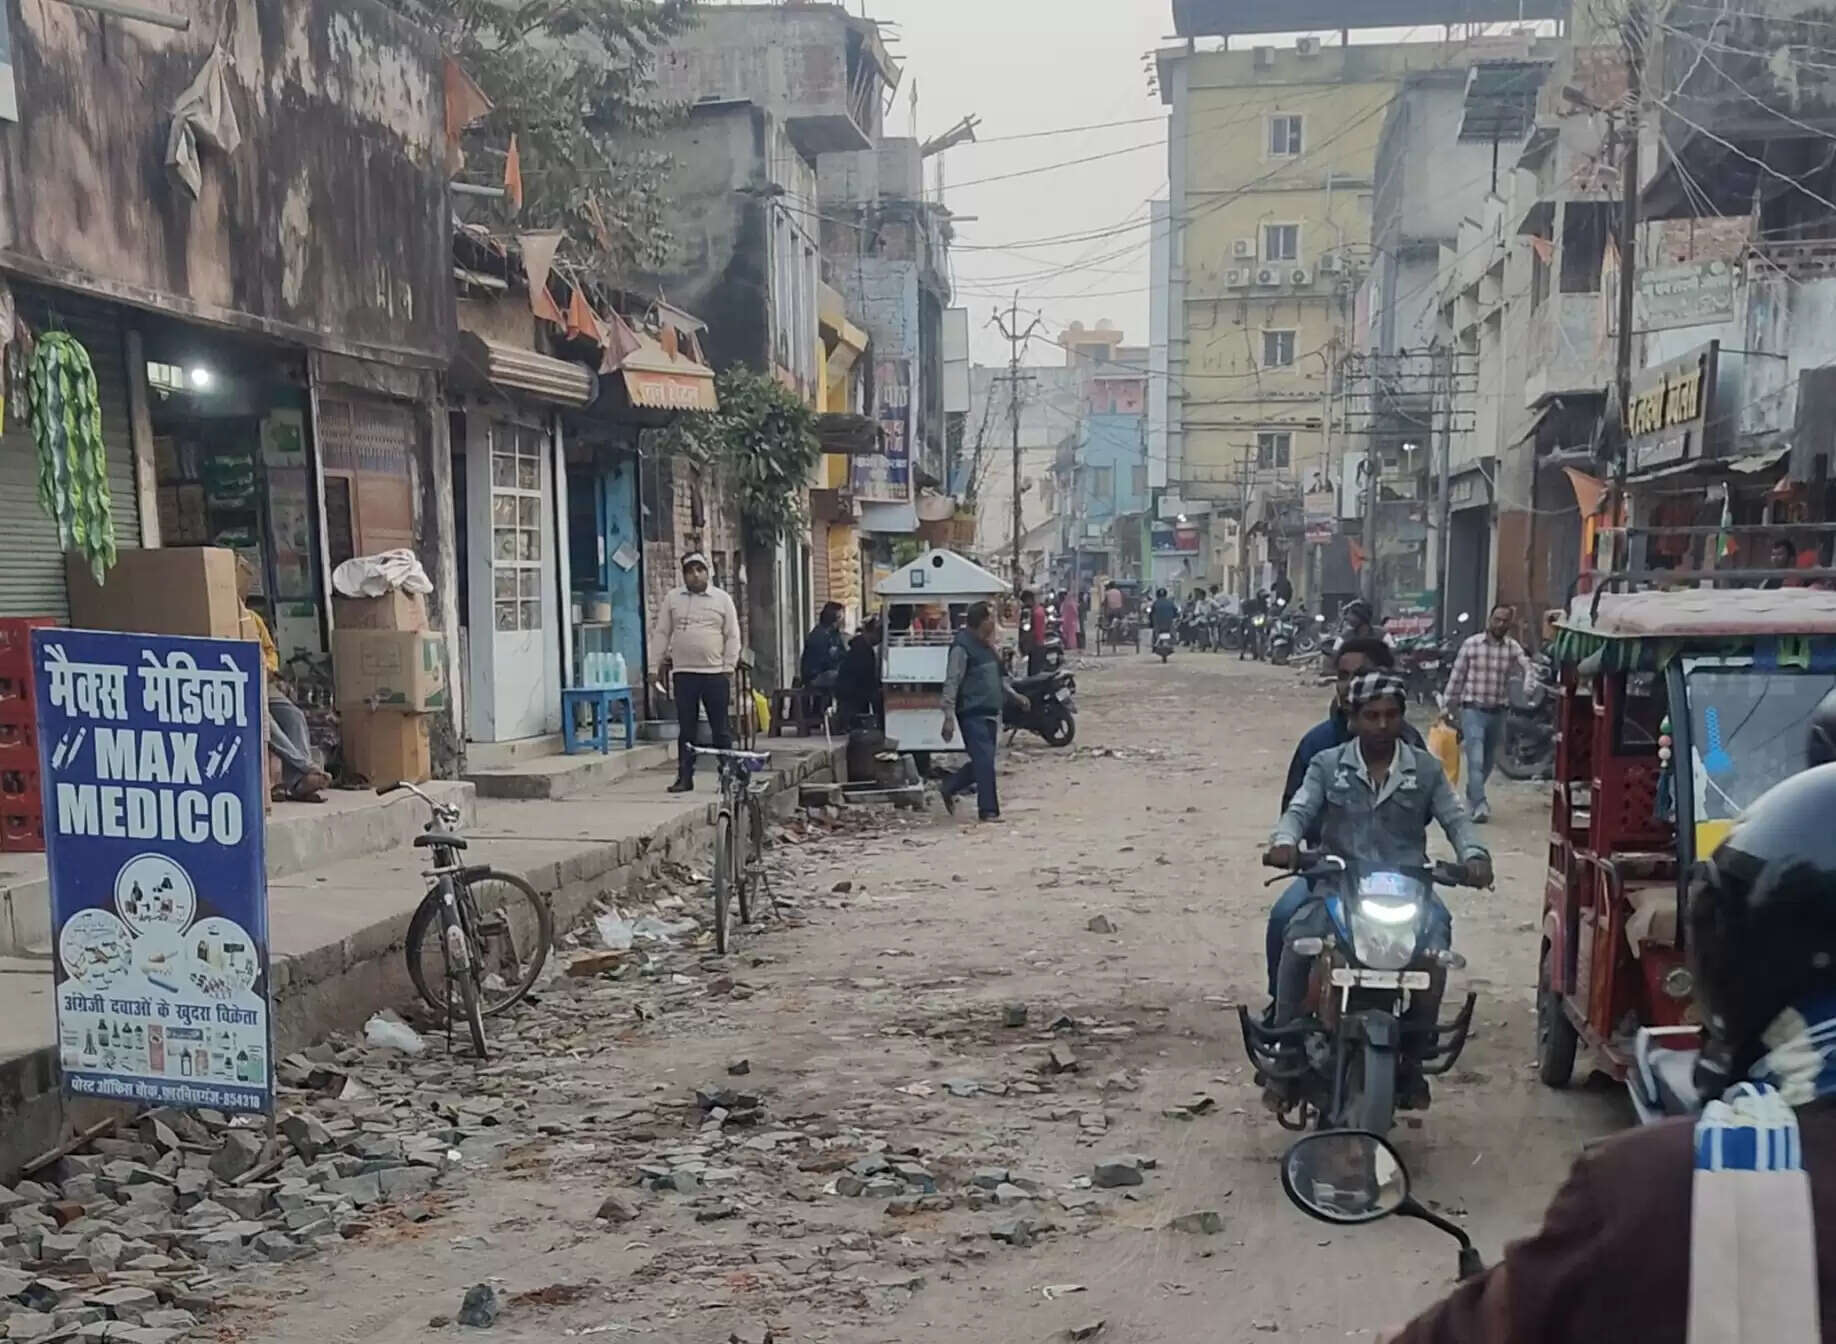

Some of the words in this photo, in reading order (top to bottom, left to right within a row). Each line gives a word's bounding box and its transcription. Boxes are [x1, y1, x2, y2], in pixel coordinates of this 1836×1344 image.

[44, 644, 129, 721] मैक्स
[137, 649, 249, 728] मेडिको
[94, 727, 203, 786] MAX
[56, 783, 244, 846] MEDICO
[64, 994, 105, 1014] अंग्रेजी
[111, 996, 151, 1017] दवाओं
[156, 999, 170, 1019] के
[175, 1003, 212, 1025] खुदरा
[216, 1003, 258, 1026] विक्रेता
[71, 1076, 94, 1093] पोस्ट
